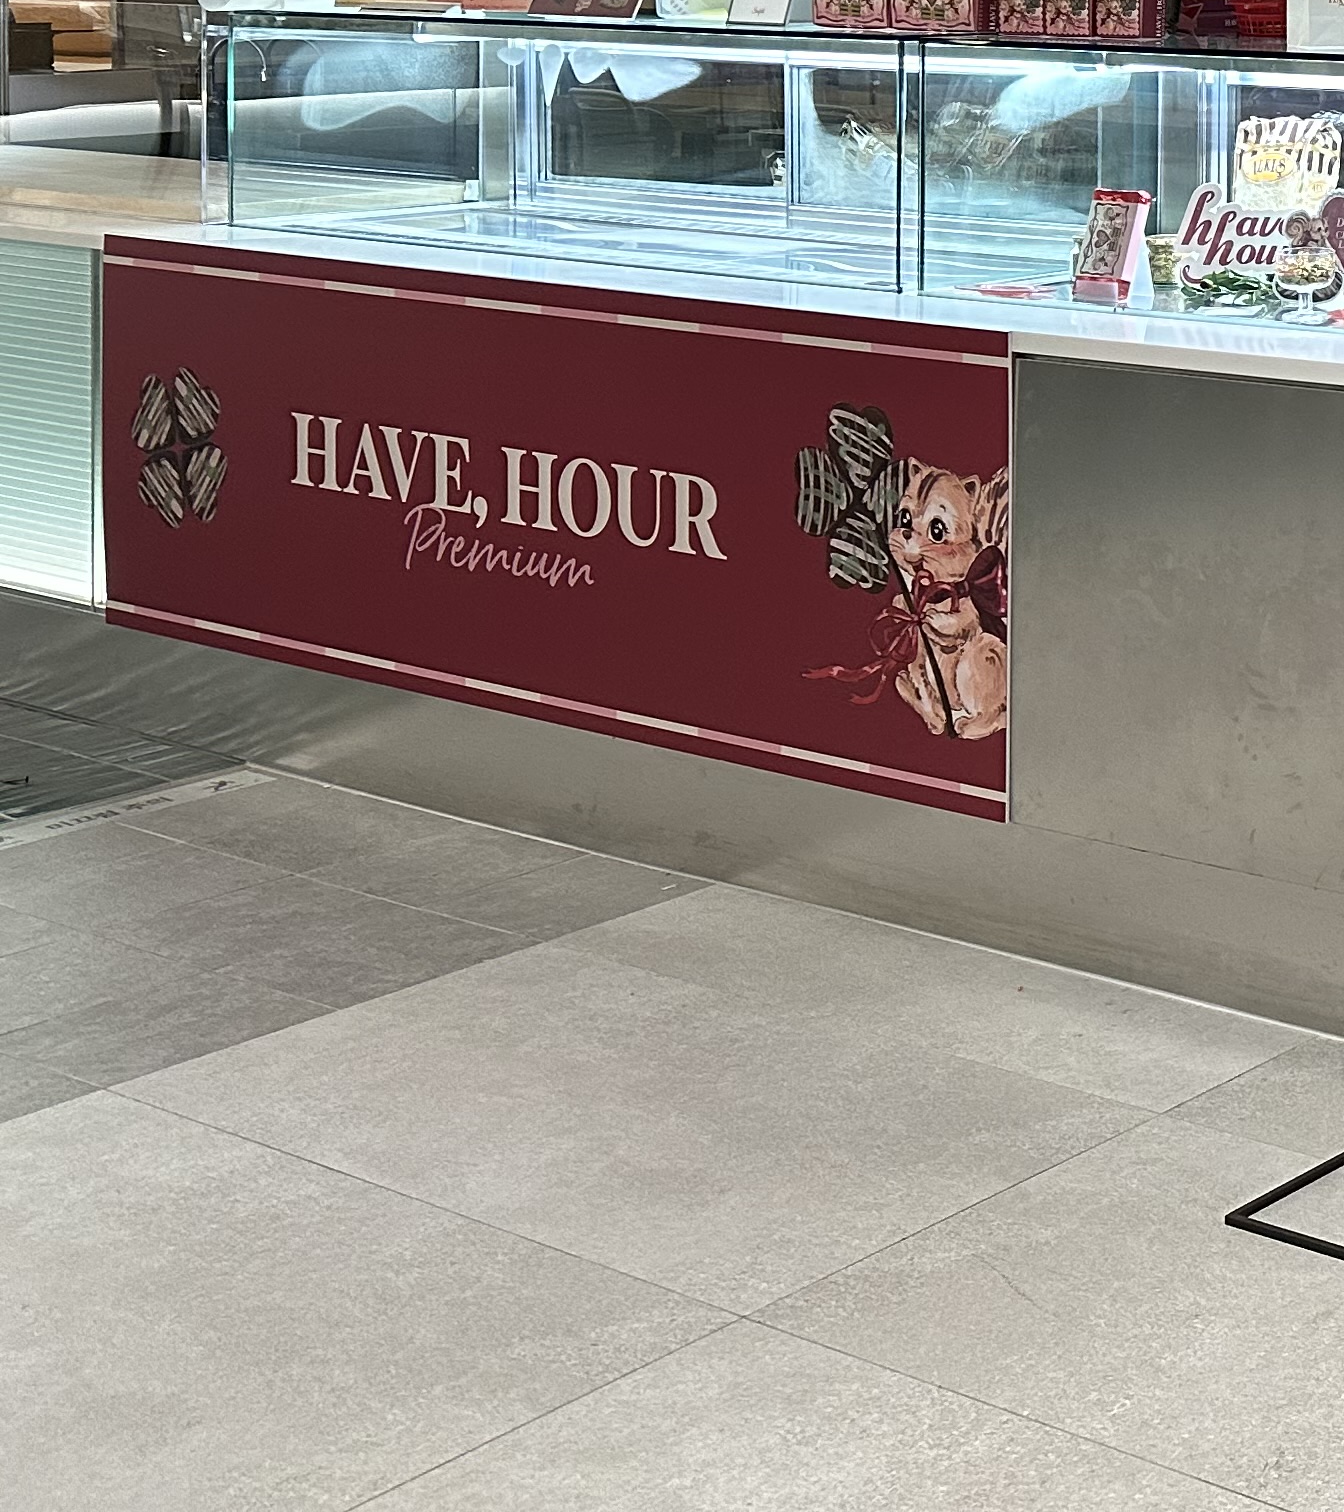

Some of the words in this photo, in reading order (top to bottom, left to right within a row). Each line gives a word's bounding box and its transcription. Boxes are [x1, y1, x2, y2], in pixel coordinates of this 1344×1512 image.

[1203, 211, 1288, 266] hou
[290, 412, 489, 528] HAVE,
[500, 447, 728, 561] HOUR
[404, 504, 595, 588] Premium
